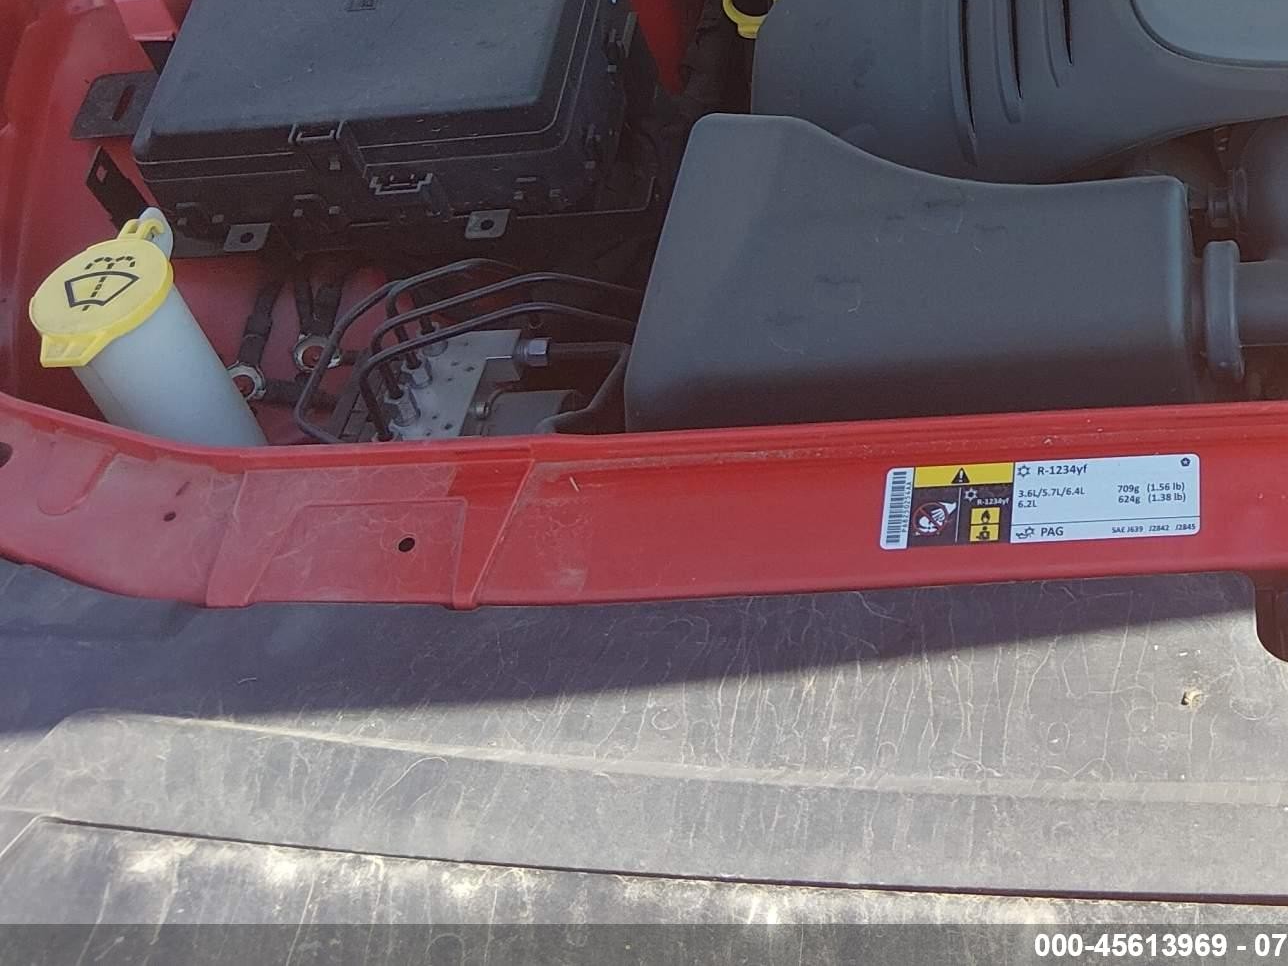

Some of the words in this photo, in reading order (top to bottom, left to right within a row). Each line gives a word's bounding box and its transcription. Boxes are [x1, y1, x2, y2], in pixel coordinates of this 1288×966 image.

[1037, 464, 1088, 476] R-1234yf
[1018, 487, 1086, 498] 3.6L/5.7L/6.4L
[1117, 484, 1141, 494] 709g
[1146, 482, 1171, 493] (1.56
[1172, 482, 1185, 492] lb)
[1017, 500, 1038, 509] 6.2L
[1118, 495, 1141, 504] 624g
[1148, 493, 1172, 504] (1.38
[1174, 492, 1186, 503] lb)
[1040, 527, 1064, 537] PAG
